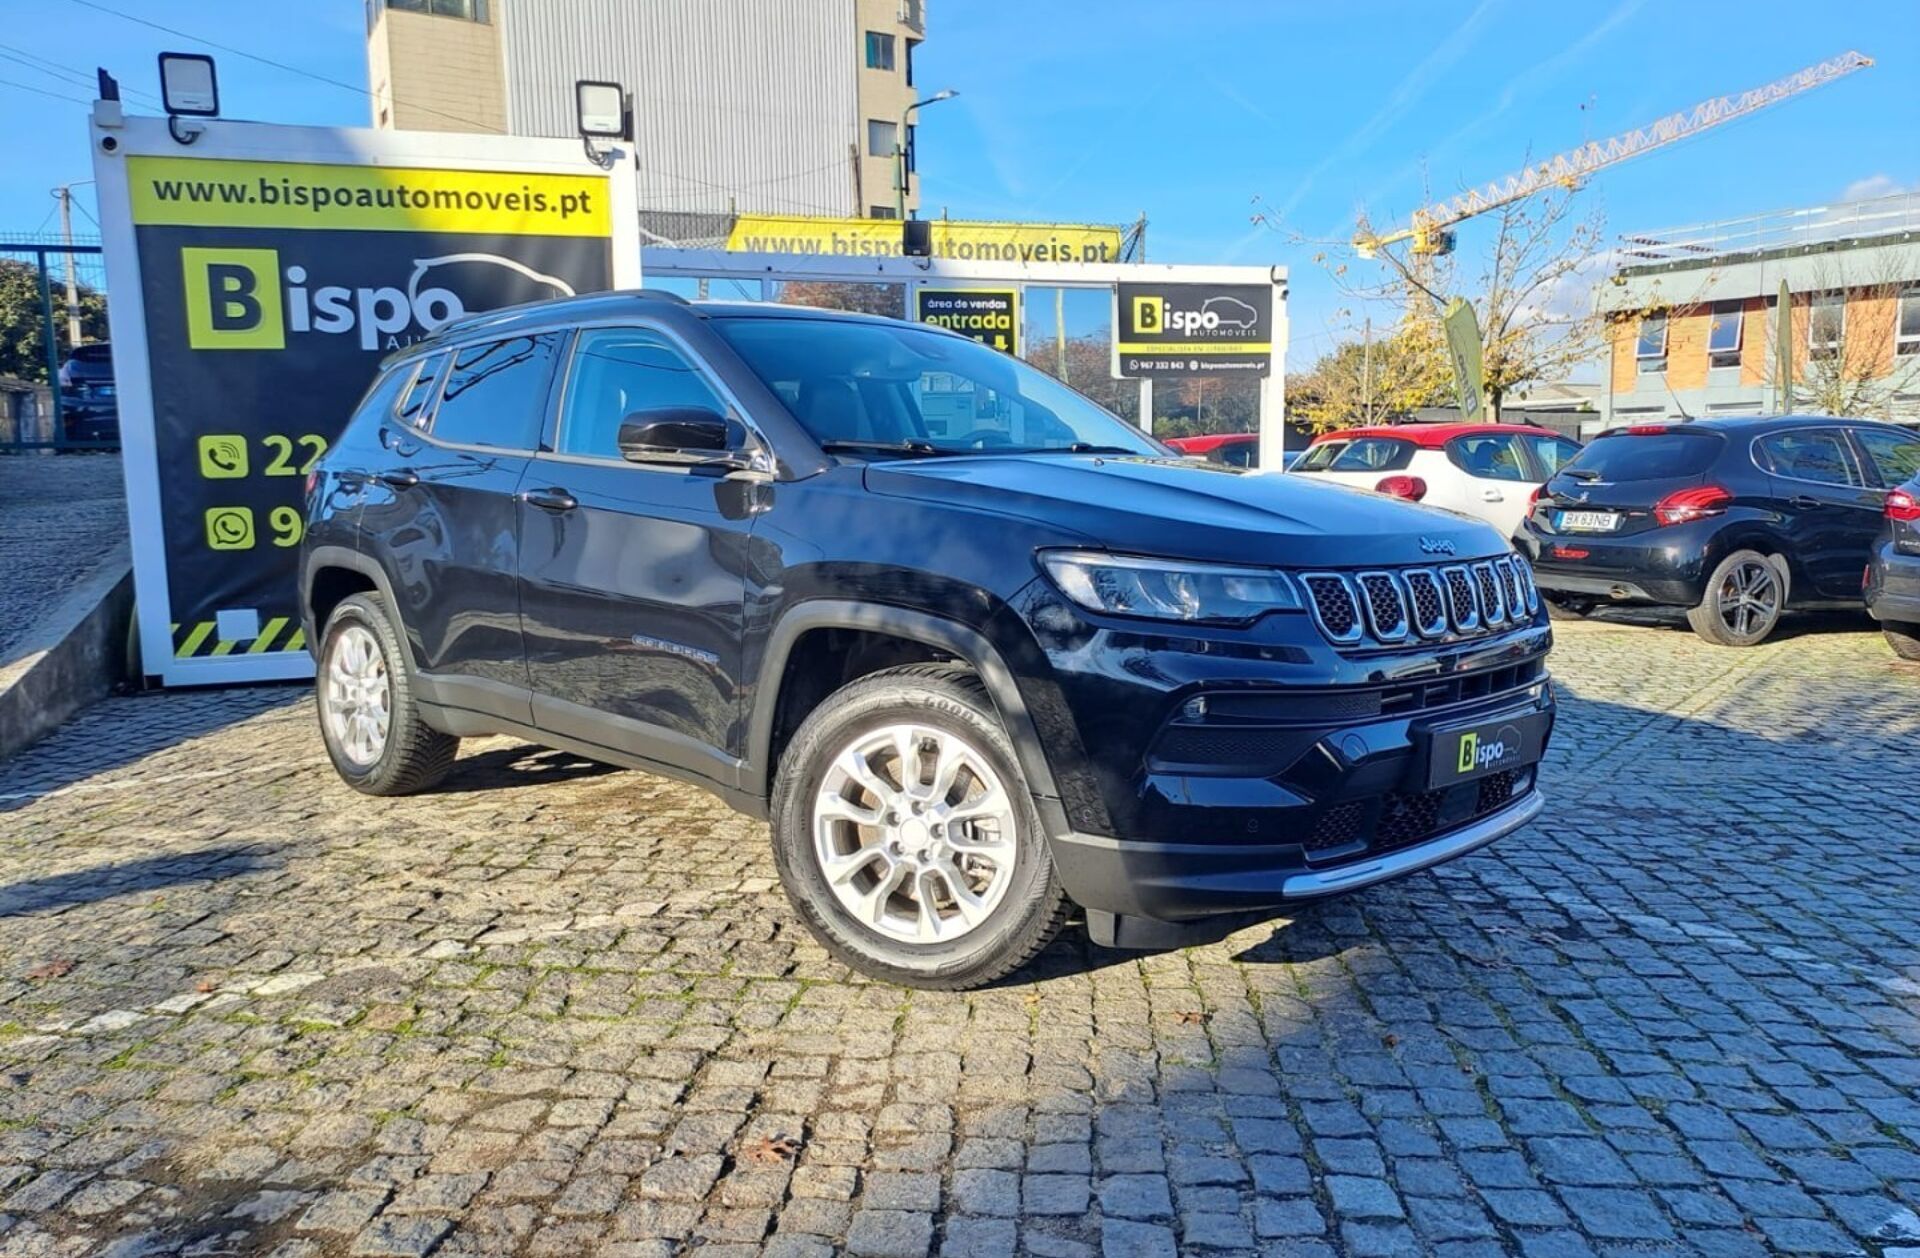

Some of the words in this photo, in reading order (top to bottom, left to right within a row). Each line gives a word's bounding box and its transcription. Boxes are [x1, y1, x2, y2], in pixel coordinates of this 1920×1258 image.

[153, 176, 591, 219] www.bispoautomoveis.pt
[205, 262, 465, 350] Bispo
[925, 310, 1010, 329] entrada
[927, 299, 952, 309] área
[954, 299, 968, 309] de
[970, 299, 1008, 309] vendas
[1140, 302, 1220, 336] Bispo
[1419, 535, 1456, 557] Jeep
[1462, 737, 1504, 769] Bispo
